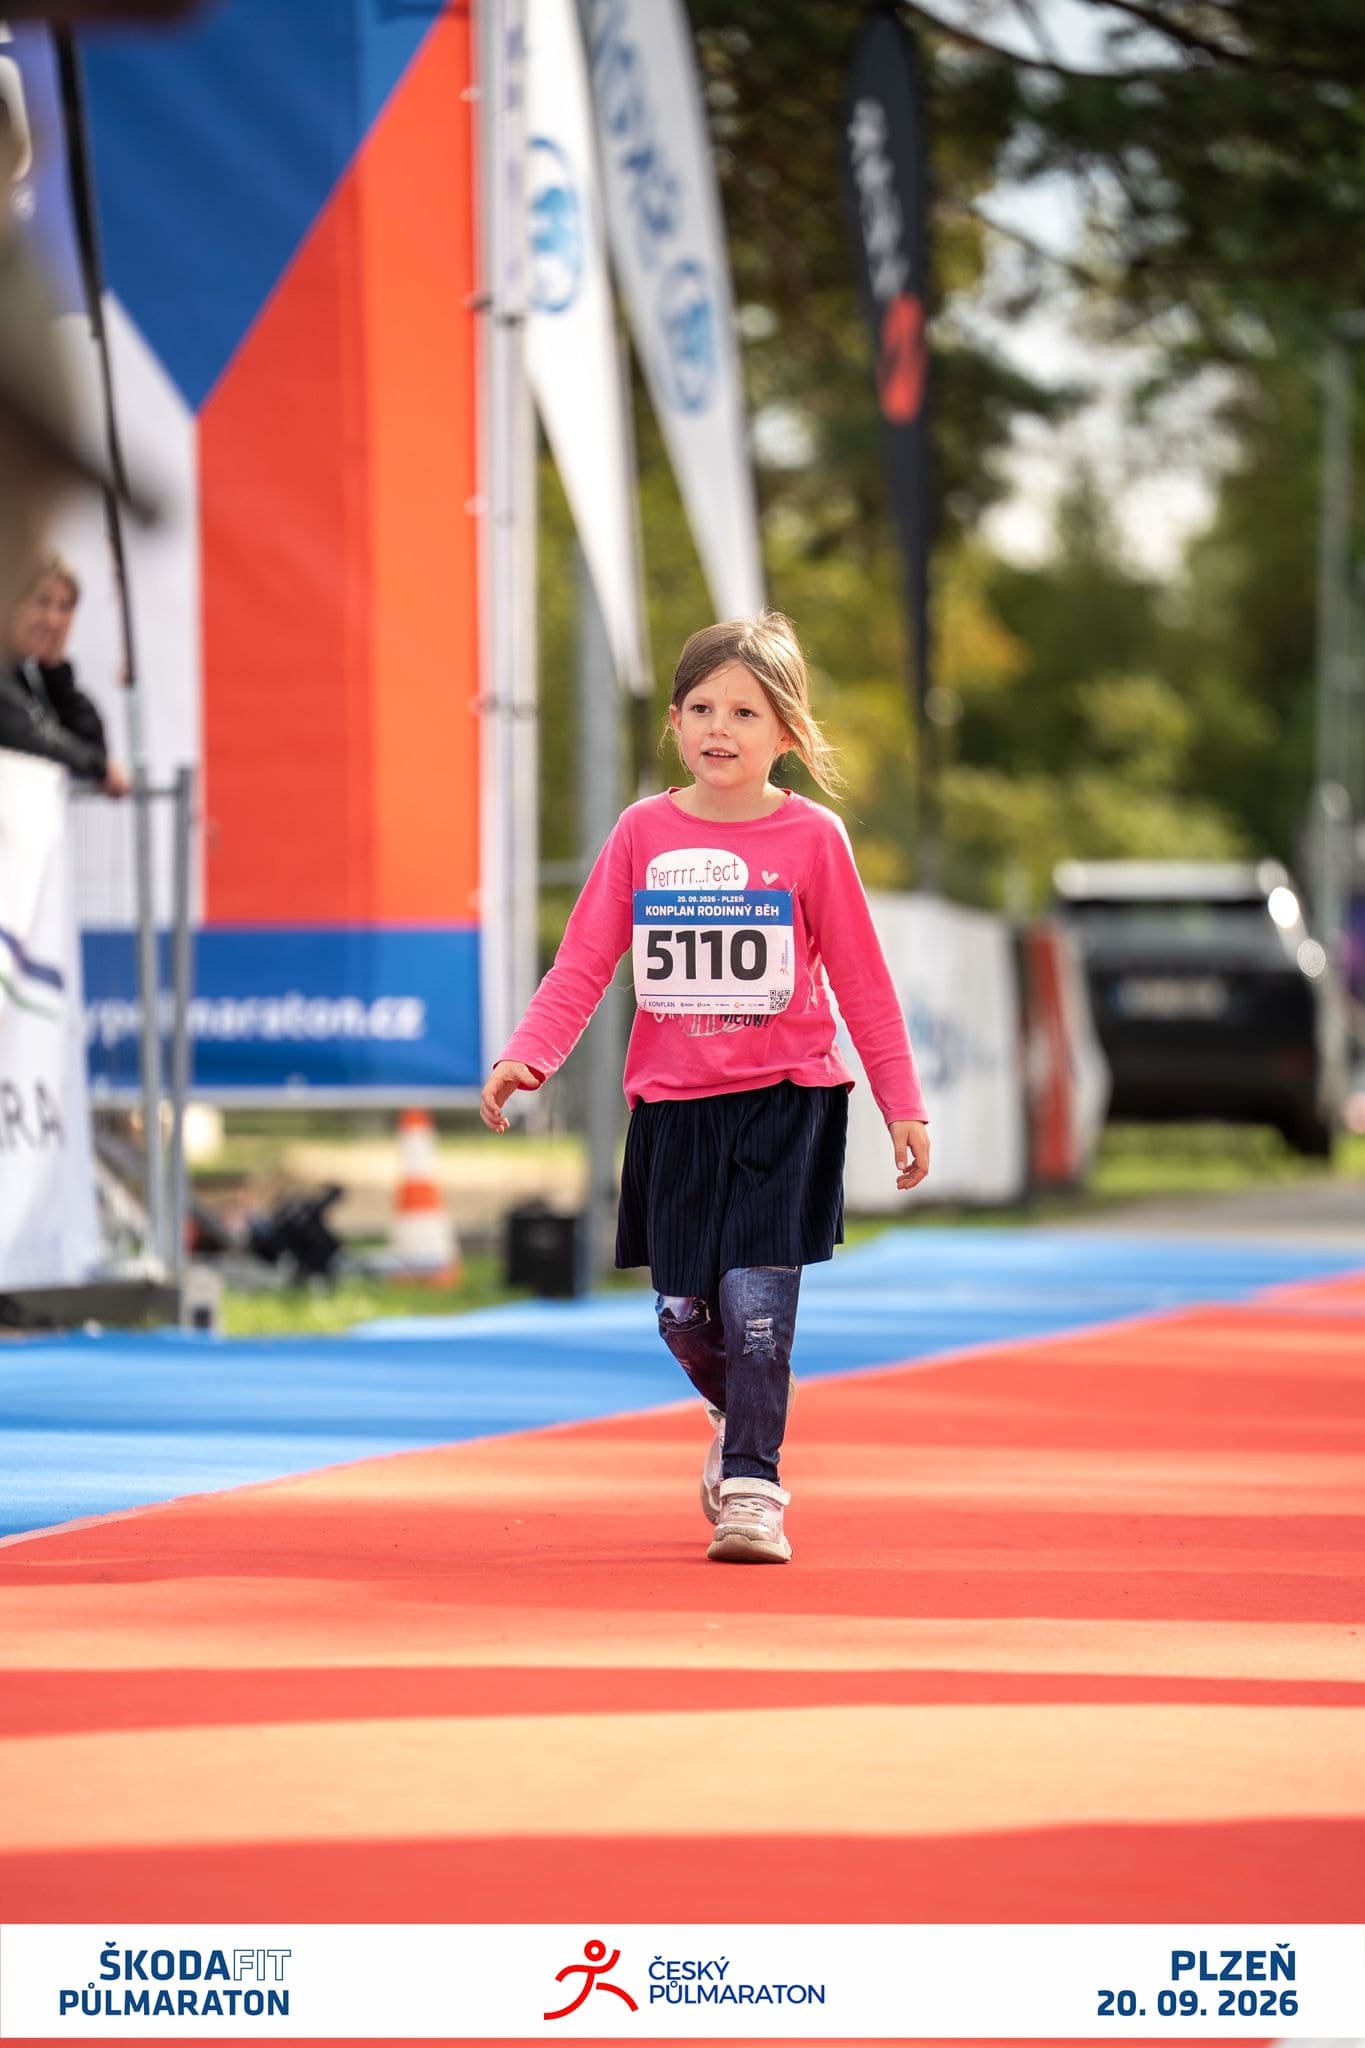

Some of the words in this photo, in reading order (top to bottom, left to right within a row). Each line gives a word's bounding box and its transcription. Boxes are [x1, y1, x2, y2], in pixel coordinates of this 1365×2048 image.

[645, 905, 696, 917] KONPLAN
[698, 904, 752, 917] RODINNÝ
[755, 904, 780, 917] BĚH
[721, 894, 744, 903] PLZEŇ
[646, 929, 768, 981] 5110
[0, 1079, 66, 1151] RA
